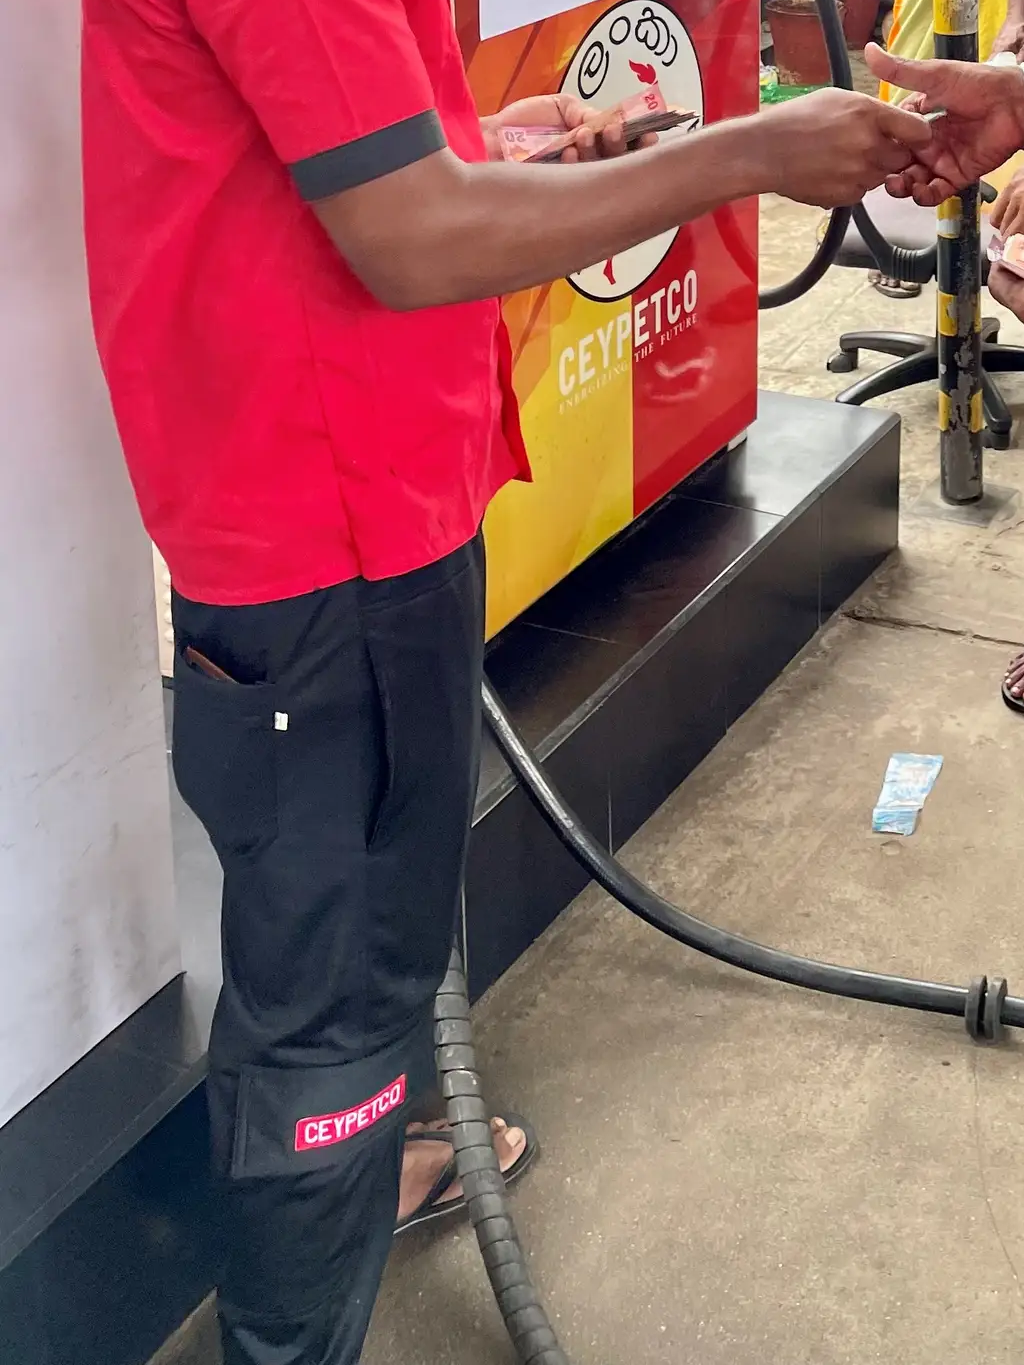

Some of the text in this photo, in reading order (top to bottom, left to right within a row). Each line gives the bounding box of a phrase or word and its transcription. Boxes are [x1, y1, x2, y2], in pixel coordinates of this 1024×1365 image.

[558, 269, 698, 396] CEYPETCO
[634, 342, 654, 363] THE
[660, 313, 698, 346] FUTURE
[304, 1083, 401, 1144] CEYPETCO
